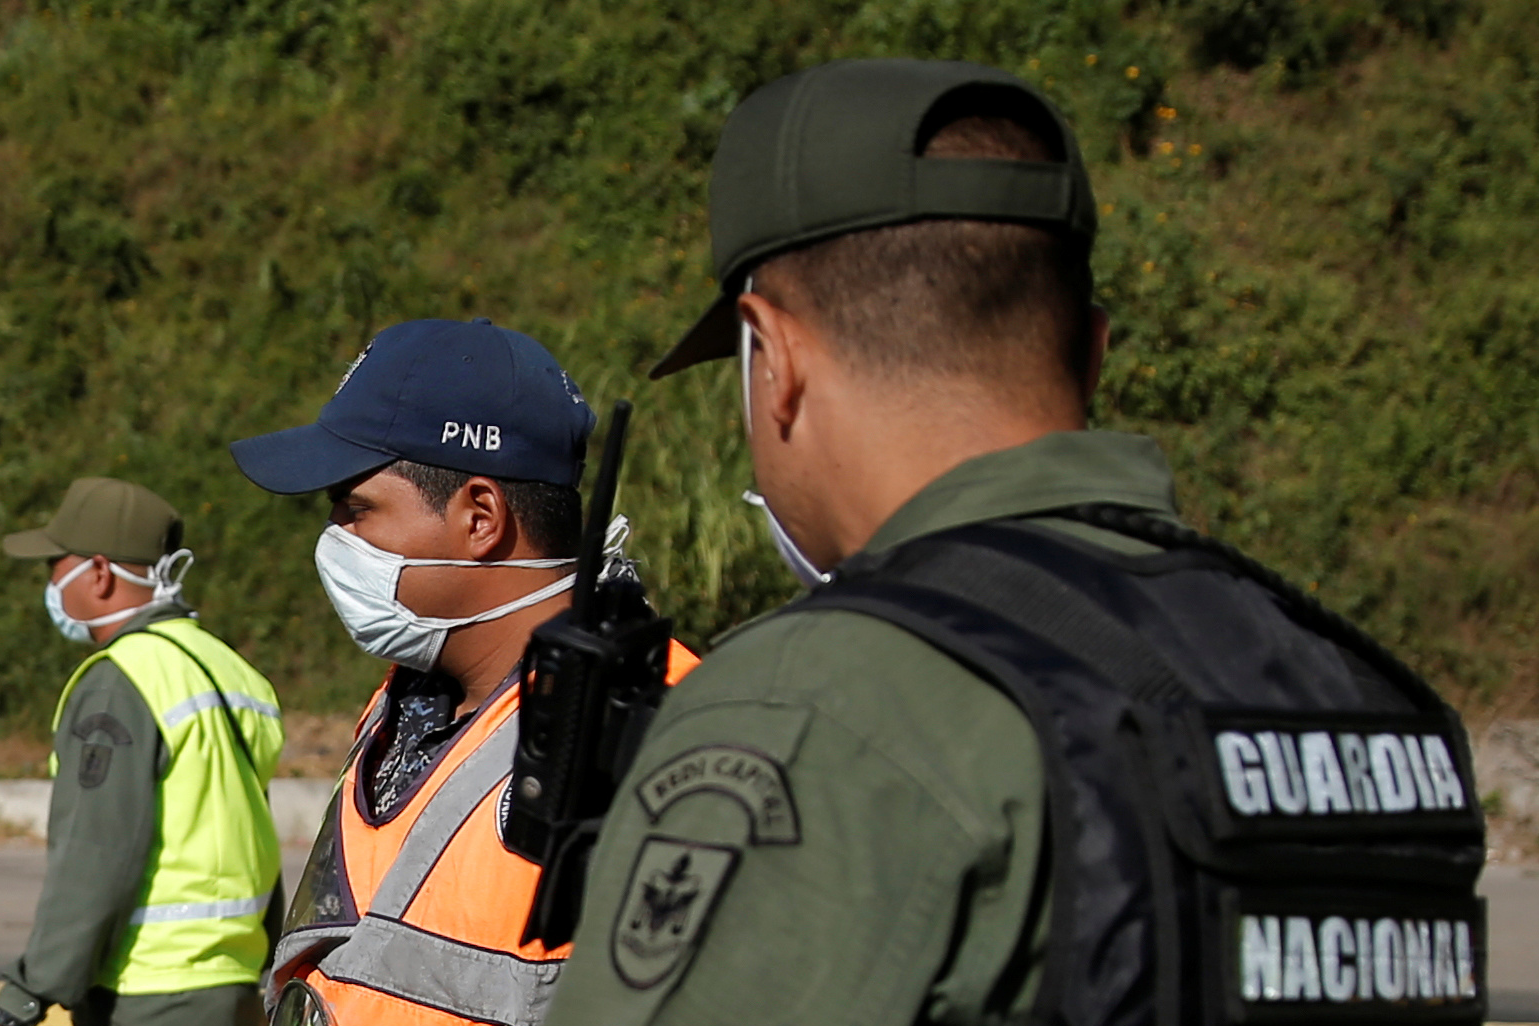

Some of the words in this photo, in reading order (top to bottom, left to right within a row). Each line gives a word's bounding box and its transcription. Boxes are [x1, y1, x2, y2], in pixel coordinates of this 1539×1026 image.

[441, 421, 502, 451] PNB
[1216, 731, 1465, 815] GUARDIA
[1240, 915, 1477, 1002] NACIONAL
